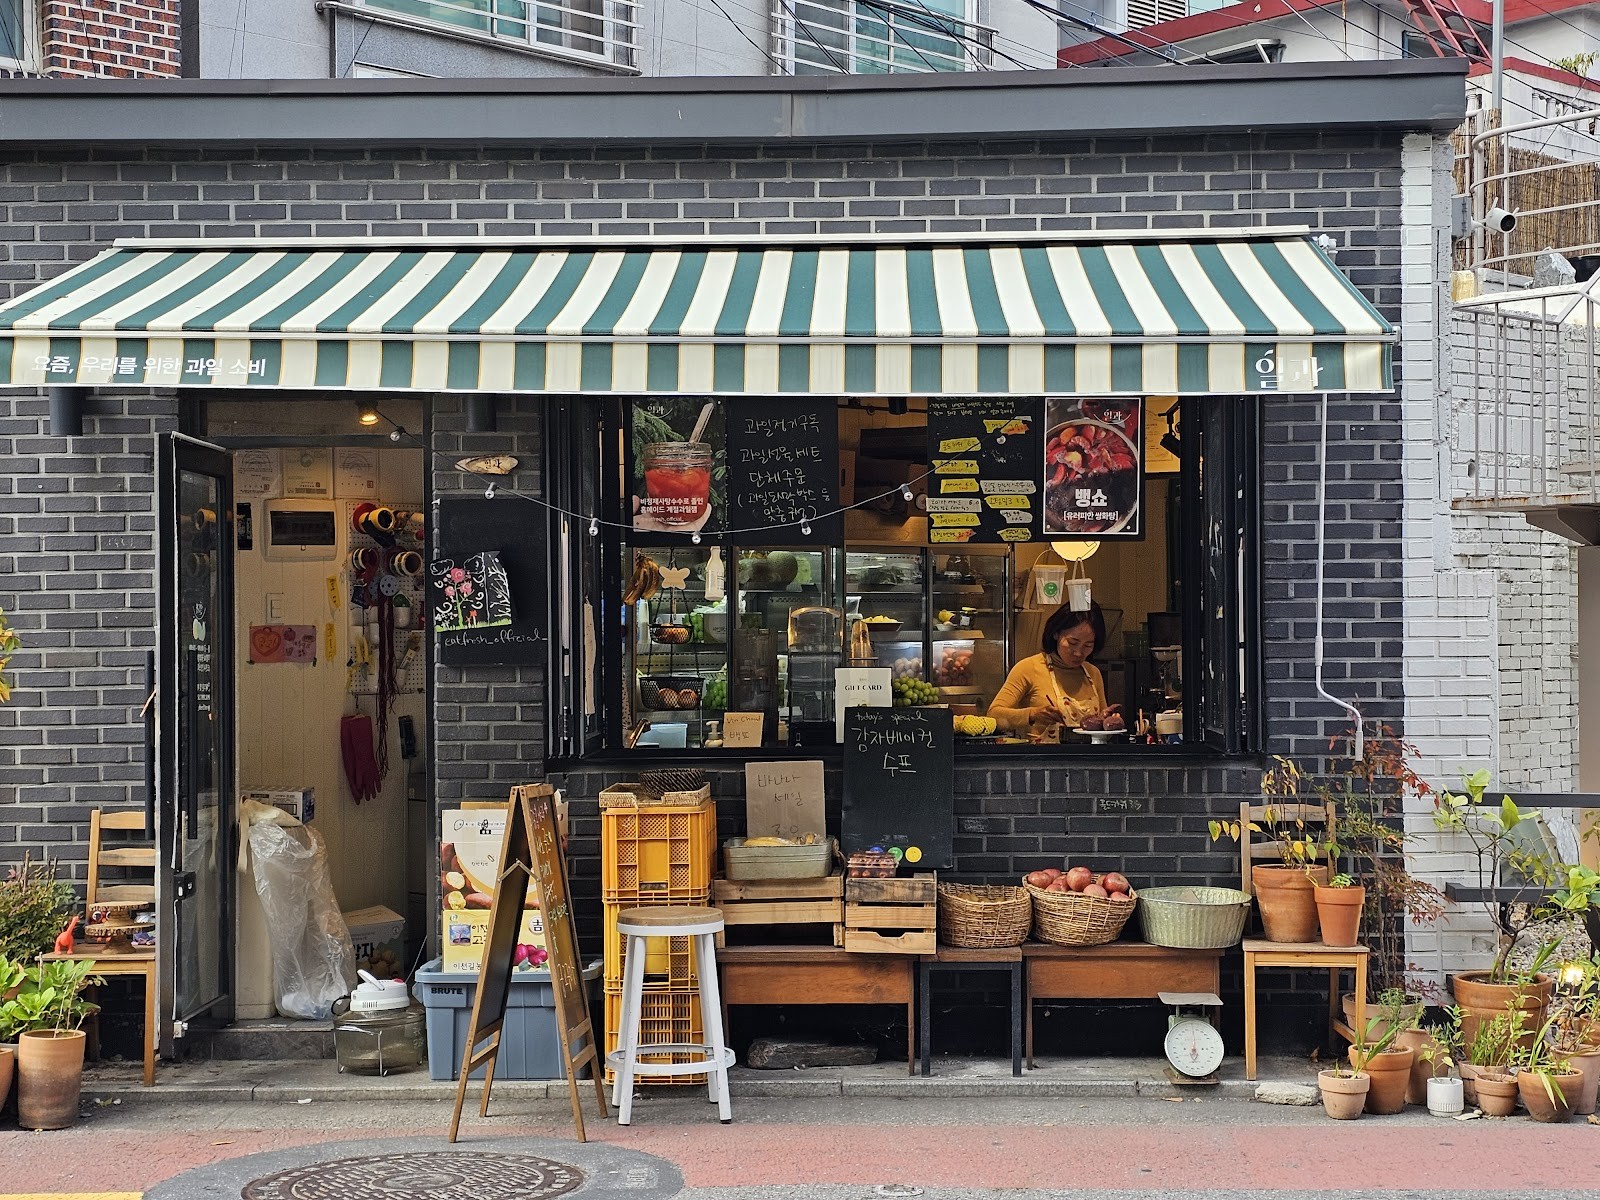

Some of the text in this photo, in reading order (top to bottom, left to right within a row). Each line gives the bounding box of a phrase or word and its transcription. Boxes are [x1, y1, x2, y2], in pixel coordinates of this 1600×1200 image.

[33, 355, 266, 377] 요즘, 우리를 위한 과일 소비
[744, 413, 820, 438] 과일정기구독
[739, 446, 823, 465] 과일선물 세트
[748, 467, 806, 488] 단체주문
[796, 488, 817, 502] 박스
[1074, 488, 1108, 508] 뱅쇼
[1063, 510, 1119, 522] [유러피안 쌍화탕]
[862, 684, 882, 692] CARD
[891, 709, 928, 725] special
[851, 726, 936, 753] 감자베이컨
[883, 751, 917, 777] 수프
[757, 774, 802, 788] 바나나
[774, 791, 803, 807] 세일
[430, 986, 463, 995] BRUTE
